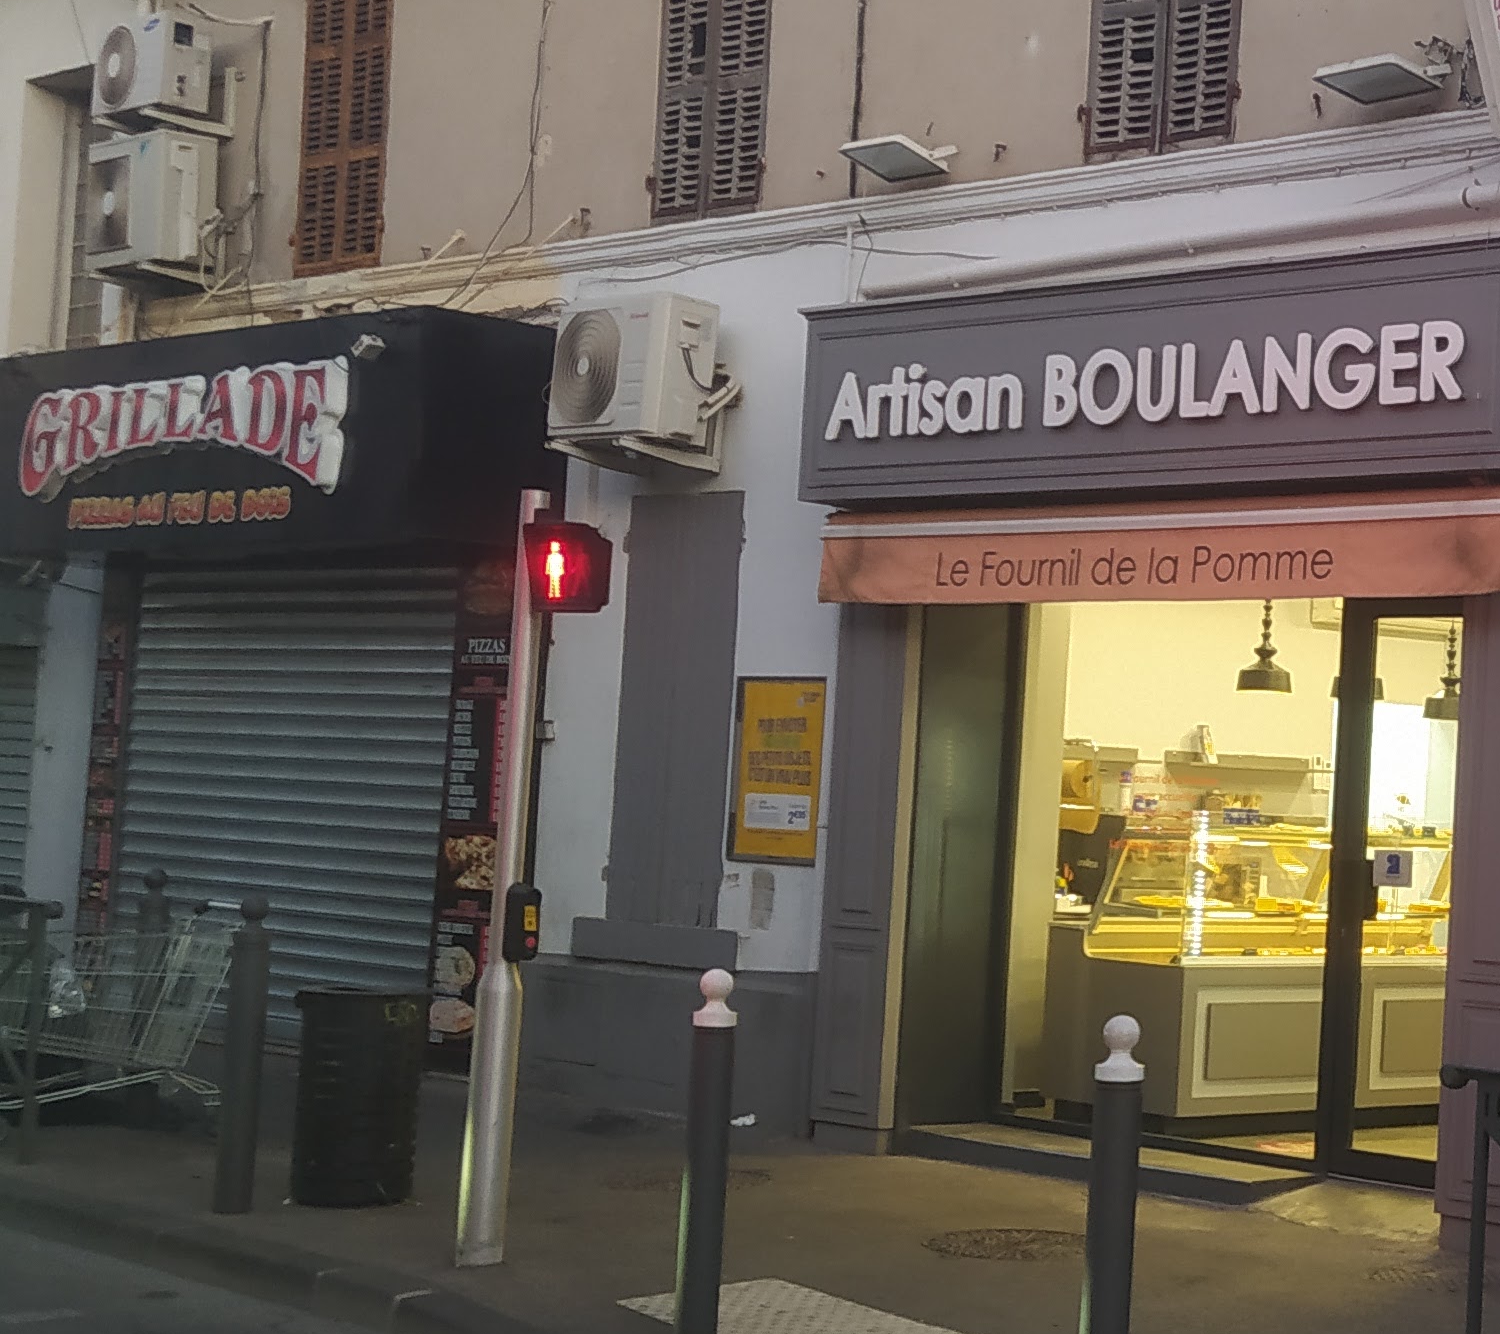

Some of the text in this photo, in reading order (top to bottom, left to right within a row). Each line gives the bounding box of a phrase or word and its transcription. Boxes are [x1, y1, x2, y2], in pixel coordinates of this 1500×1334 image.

[824, 320, 1466, 442] Artisan BOULANGER
[19, 362, 335, 496] GRILLADE
[936, 545, 1335, 588] Le Fournil de la Pomme
[467, 638, 506, 654] PIZZAS
